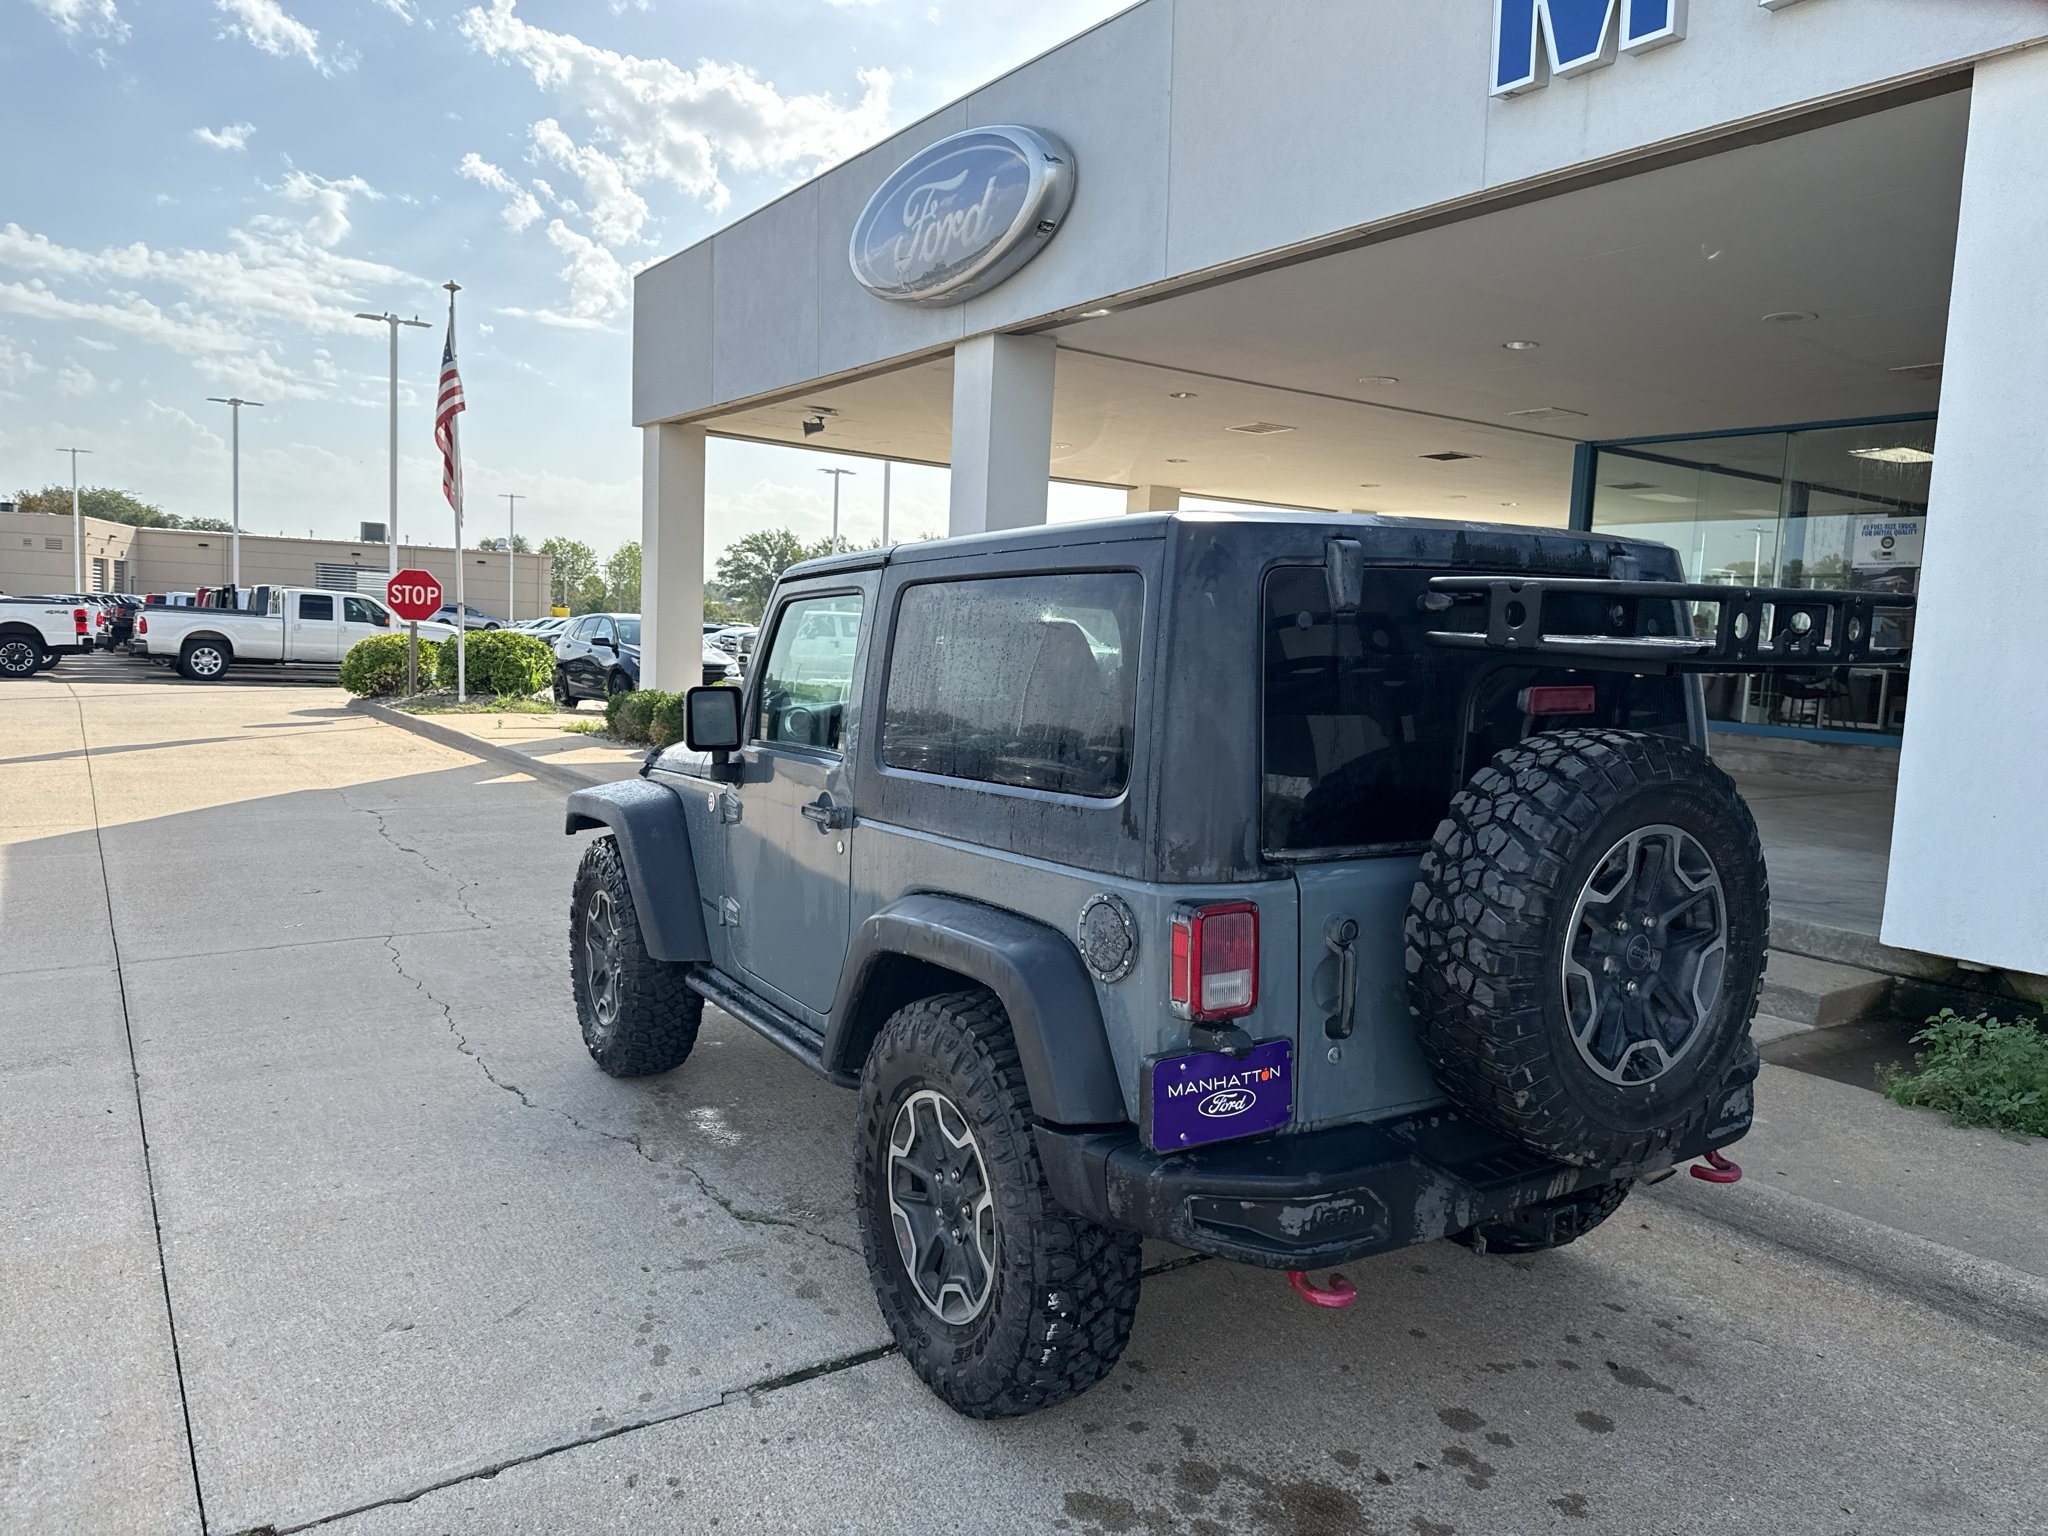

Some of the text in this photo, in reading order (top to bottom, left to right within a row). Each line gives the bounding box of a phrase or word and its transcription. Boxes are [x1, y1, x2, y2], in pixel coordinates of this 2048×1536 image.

[894, 169, 997, 267] Ford
[1894, 528, 1918, 536] QUALITY
[390, 584, 439, 605] STOP
[1167, 1065, 1281, 1098] MANHATTN
[1208, 1093, 1247, 1114] Ford
